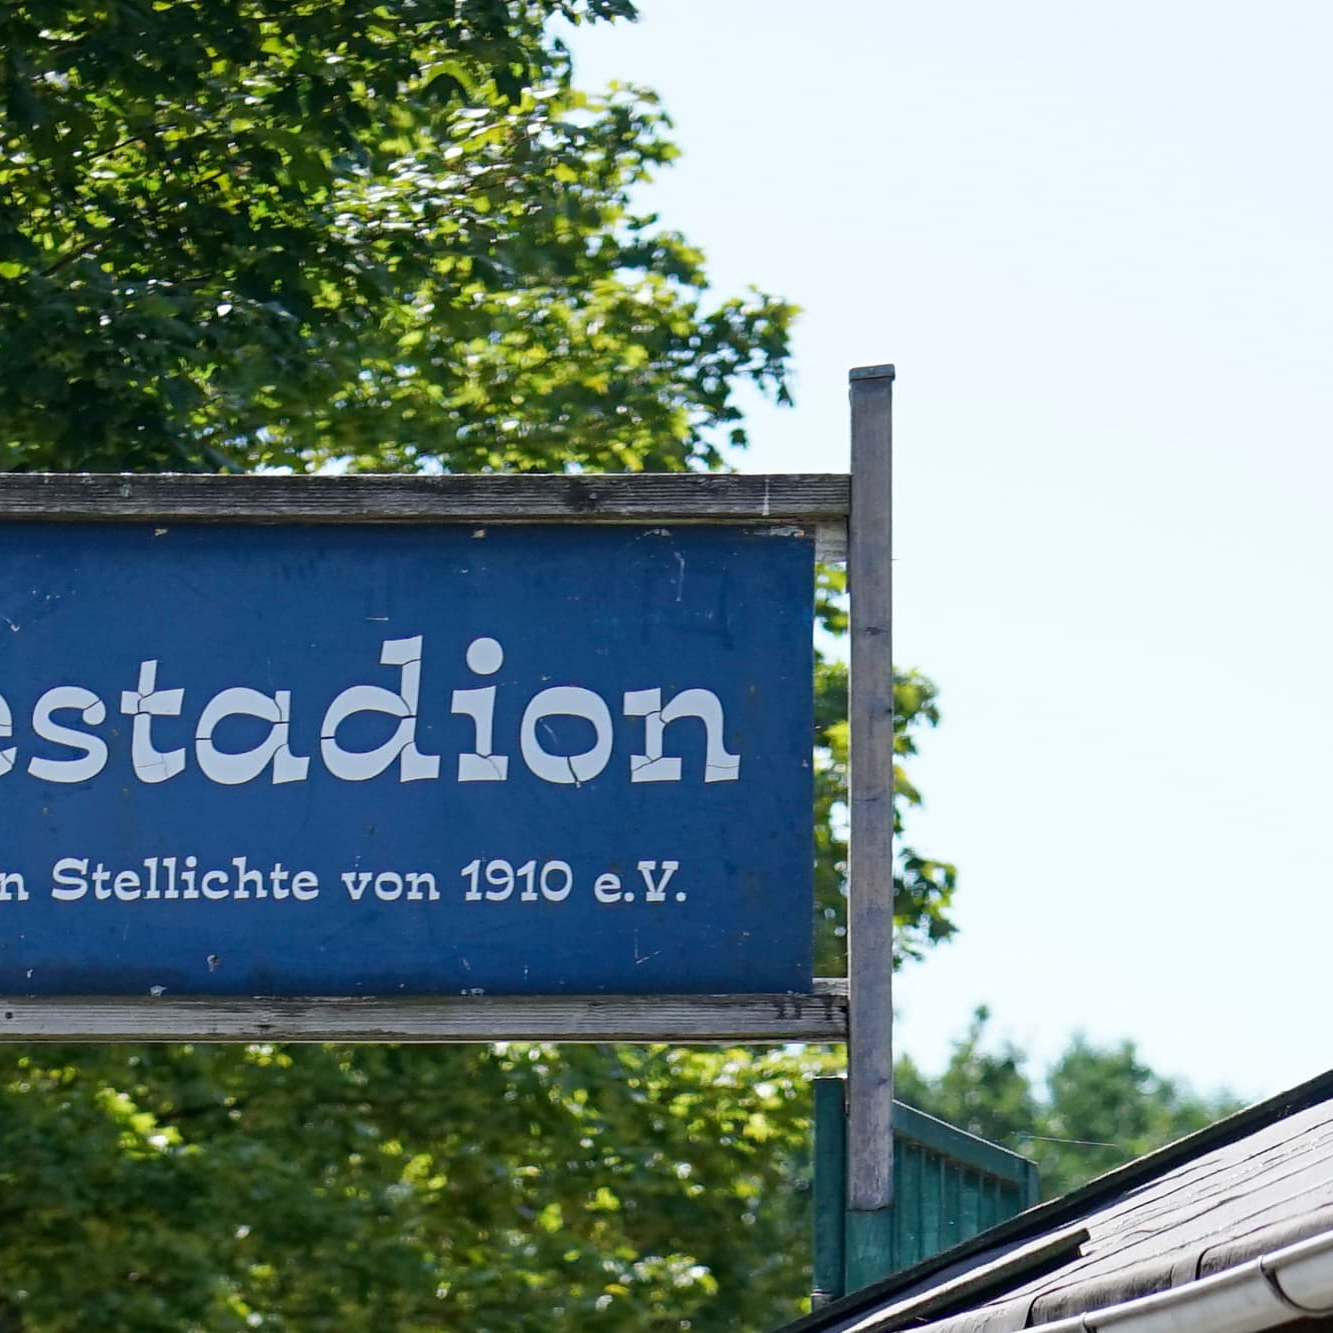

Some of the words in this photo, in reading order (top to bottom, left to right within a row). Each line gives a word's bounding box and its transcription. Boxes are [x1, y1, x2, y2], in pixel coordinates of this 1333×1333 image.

[51, 857, 319, 901] Stellichte
[341, 872, 440, 901] von
[461, 859, 573, 902] 1910
[594, 860, 688, 903] e.V.
